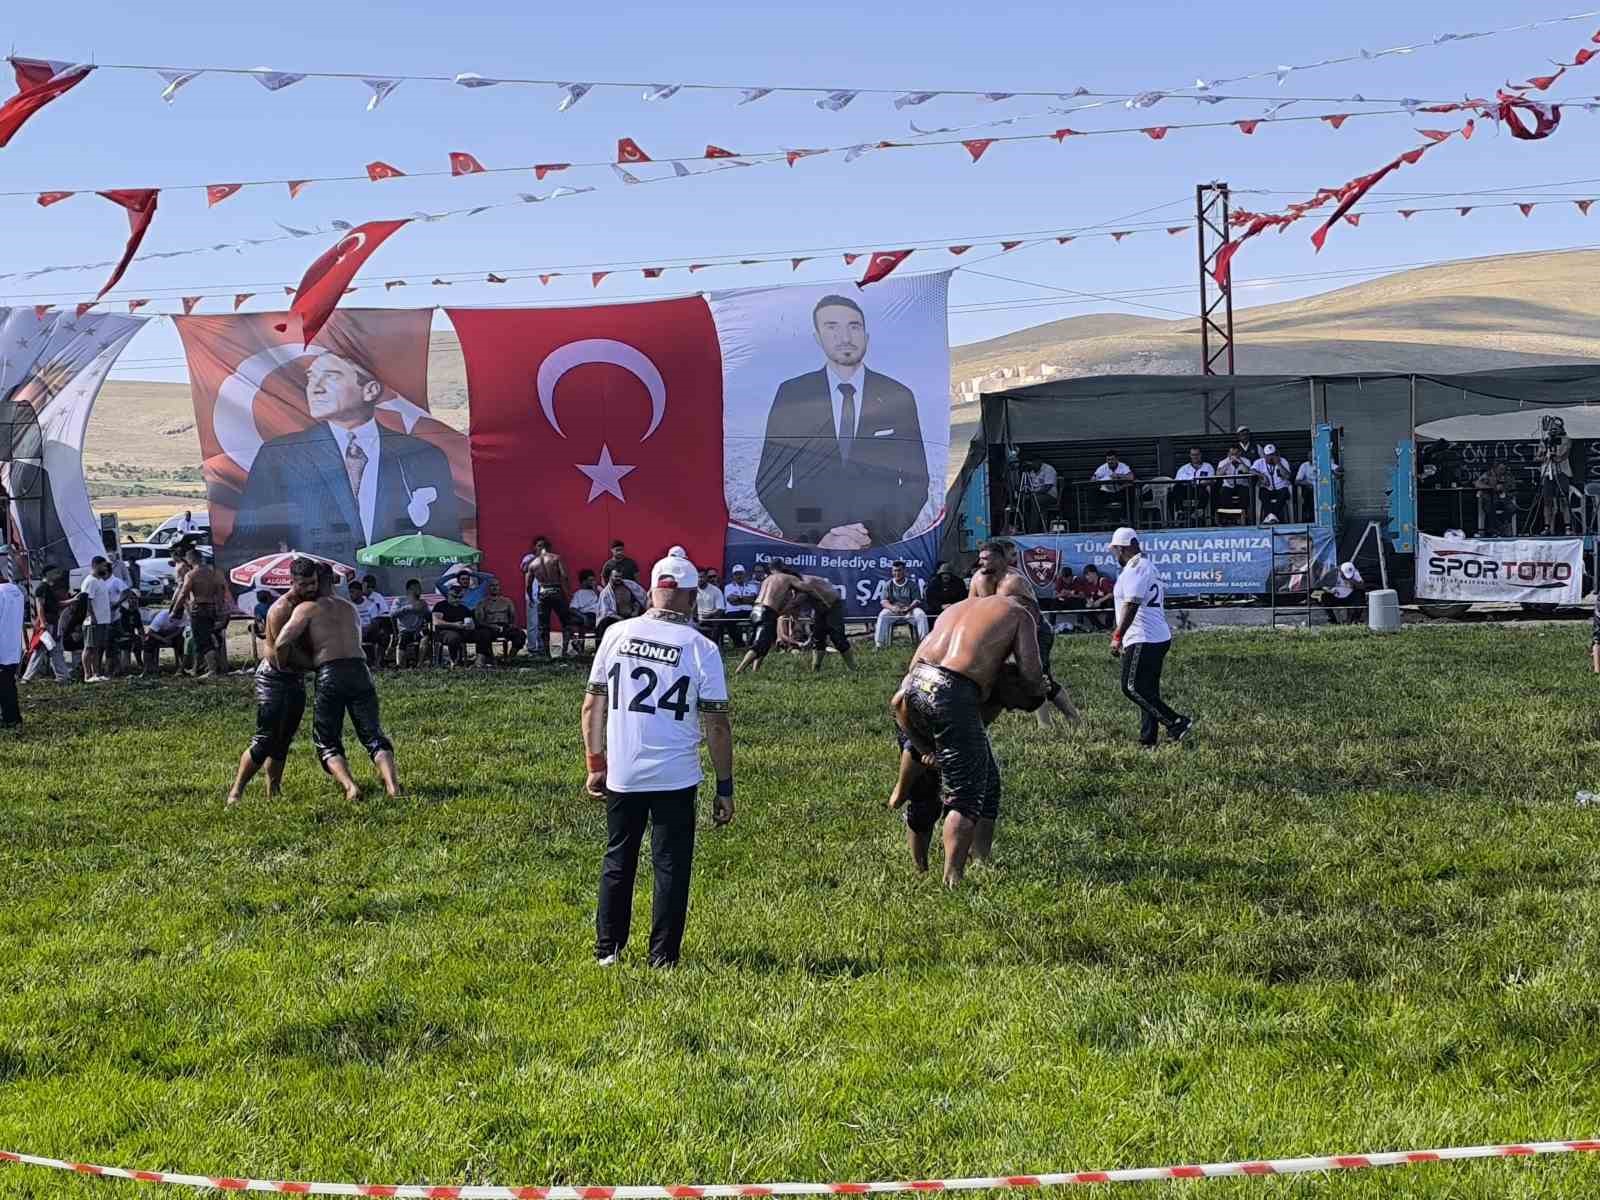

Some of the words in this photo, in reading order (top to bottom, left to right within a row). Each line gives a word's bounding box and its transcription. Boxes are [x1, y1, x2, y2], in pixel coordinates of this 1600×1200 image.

[1140, 537, 1272, 552] LİVANLARIMIZA
[393, 556, 414, 566] Golf
[821, 556, 876, 571] Belediye
[1187, 551, 1252, 564] DİLERİM
[1176, 568, 1224, 582] TÜRKİŞ
[619, 641, 679, 663] ÖZÜNLÜ
[608, 662, 691, 721] 124
